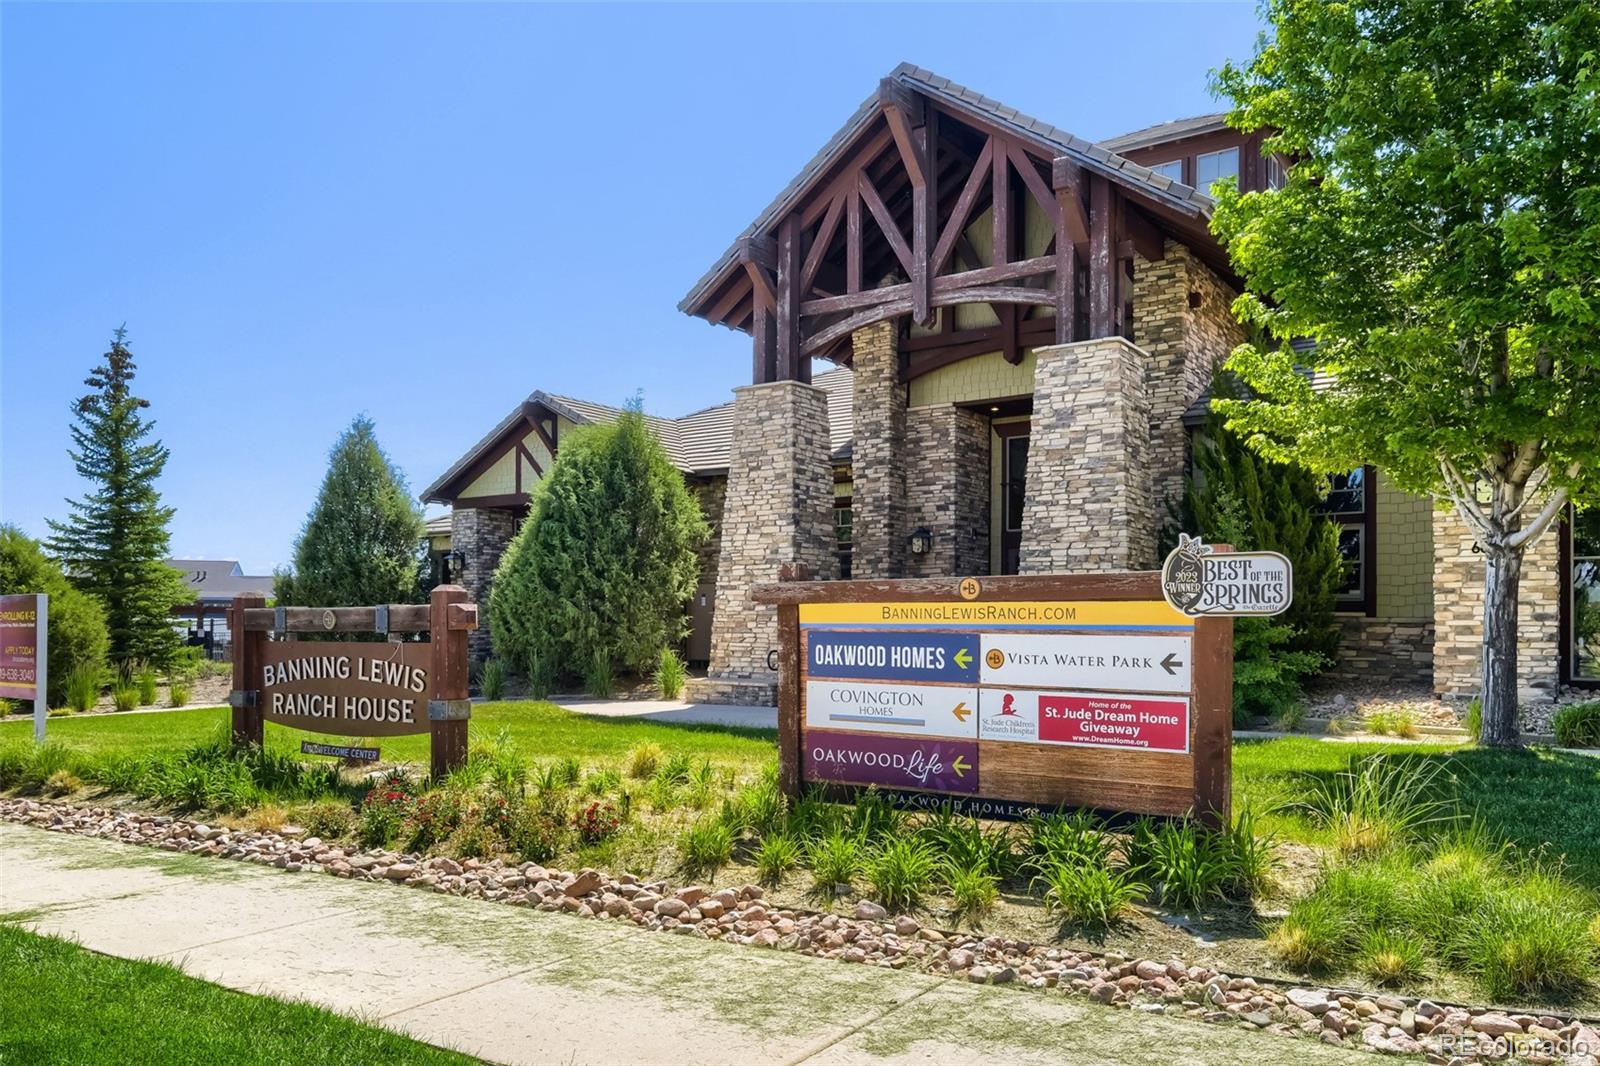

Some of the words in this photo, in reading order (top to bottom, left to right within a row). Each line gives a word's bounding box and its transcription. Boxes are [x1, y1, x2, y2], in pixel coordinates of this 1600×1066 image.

[1175, 572, 1198, 583] 2023
[1204, 560, 1252, 582] BEST
[1250, 571, 1262, 582] OF
[1264, 571, 1283, 582] THE
[1165, 582, 1201, 593] WINNER
[1203, 583, 1284, 606] SPRINGS
[814, 644, 886, 667] OAKWOOD
[891, 646, 945, 669] HOMES
[263, 656, 350, 687] BANNING
[358, 657, 427, 694] LEWIS
[830, 689, 923, 706] COVINGTON
[1088, 701, 1109, 709] Home
[1120, 702, 1132, 710] the
[272, 693, 336, 718] RANCH
[344, 697, 416, 723] HOUSE
[859, 706, 893, 717] HOMES
[1045, 707, 1060, 718] St.
[1063, 708, 1092, 720] Jude
[1095, 710, 1136, 722] Dream
[1140, 712, 1179, 725] Home
[982, 724, 1009, 733] Research
[1009, 726, 1035, 736] Hospital
[1080, 721, 1140, 738] Giveaway
[1072, 735, 1149, 747] www.DreamHome.org
[350, 749, 378, 760] CENTER
[812, 747, 904, 769] OAKWOOD
[903, 750, 944, 782] Life
[971, 802, 1024, 816] HOMES
